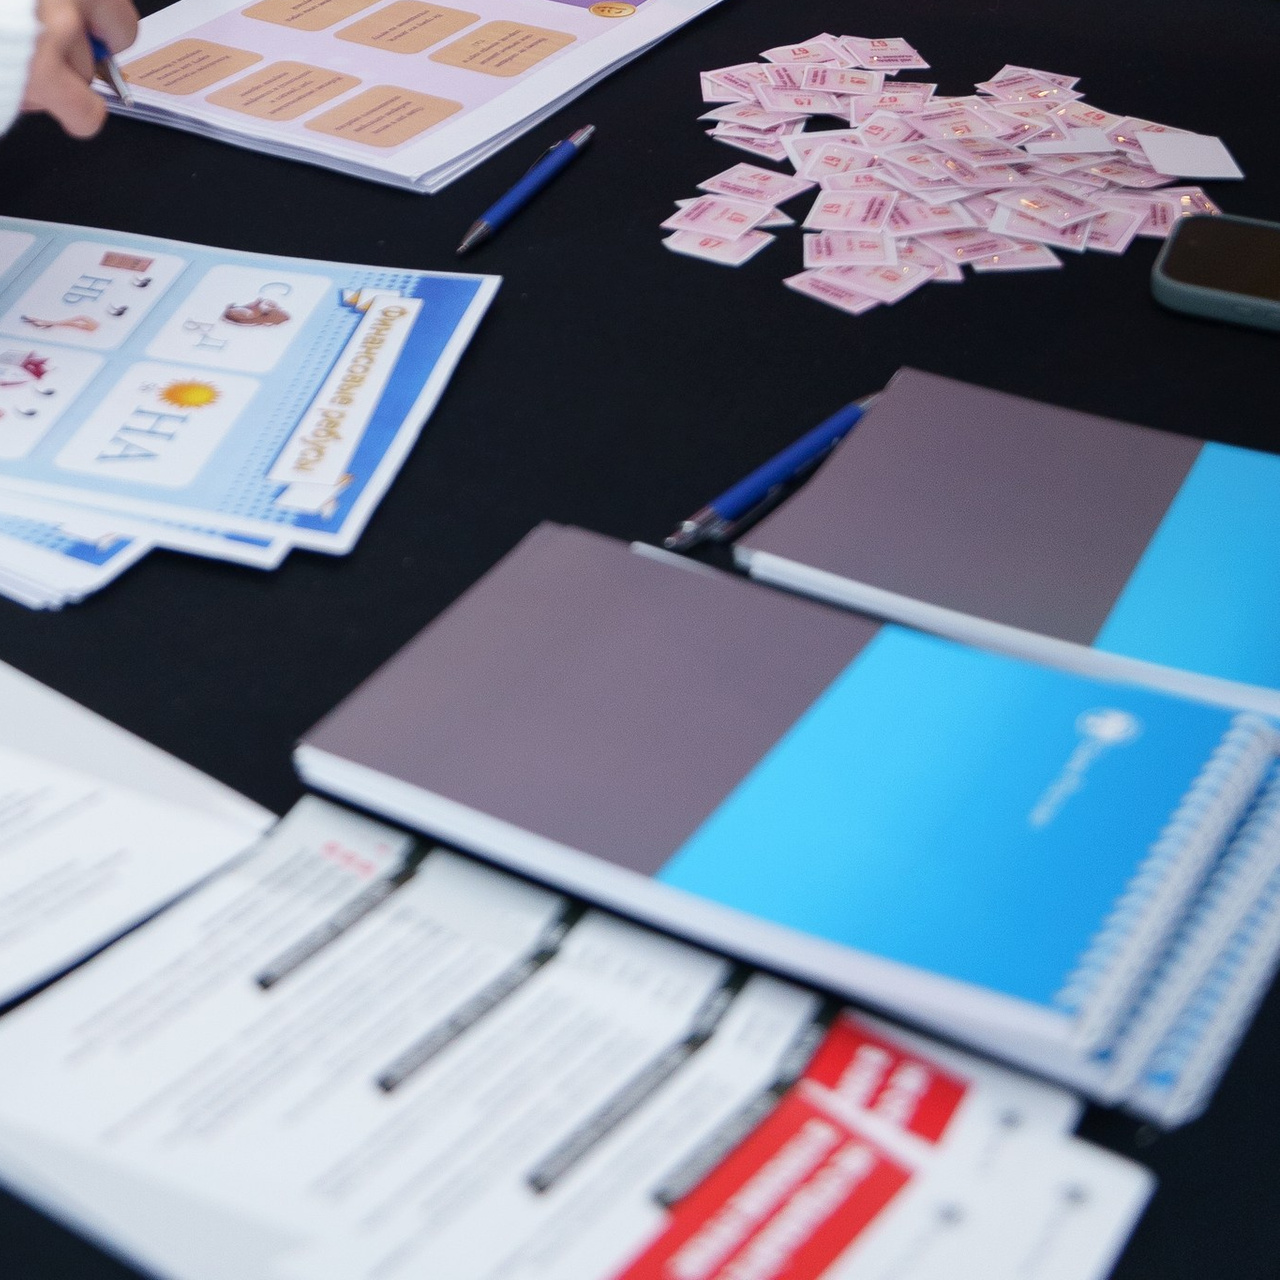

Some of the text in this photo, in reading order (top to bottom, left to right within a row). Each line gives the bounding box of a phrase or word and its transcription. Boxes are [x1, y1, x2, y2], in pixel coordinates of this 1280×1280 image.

[95, 404, 190, 465] НА
[292, 303, 408, 472] Финансовые ребусы
